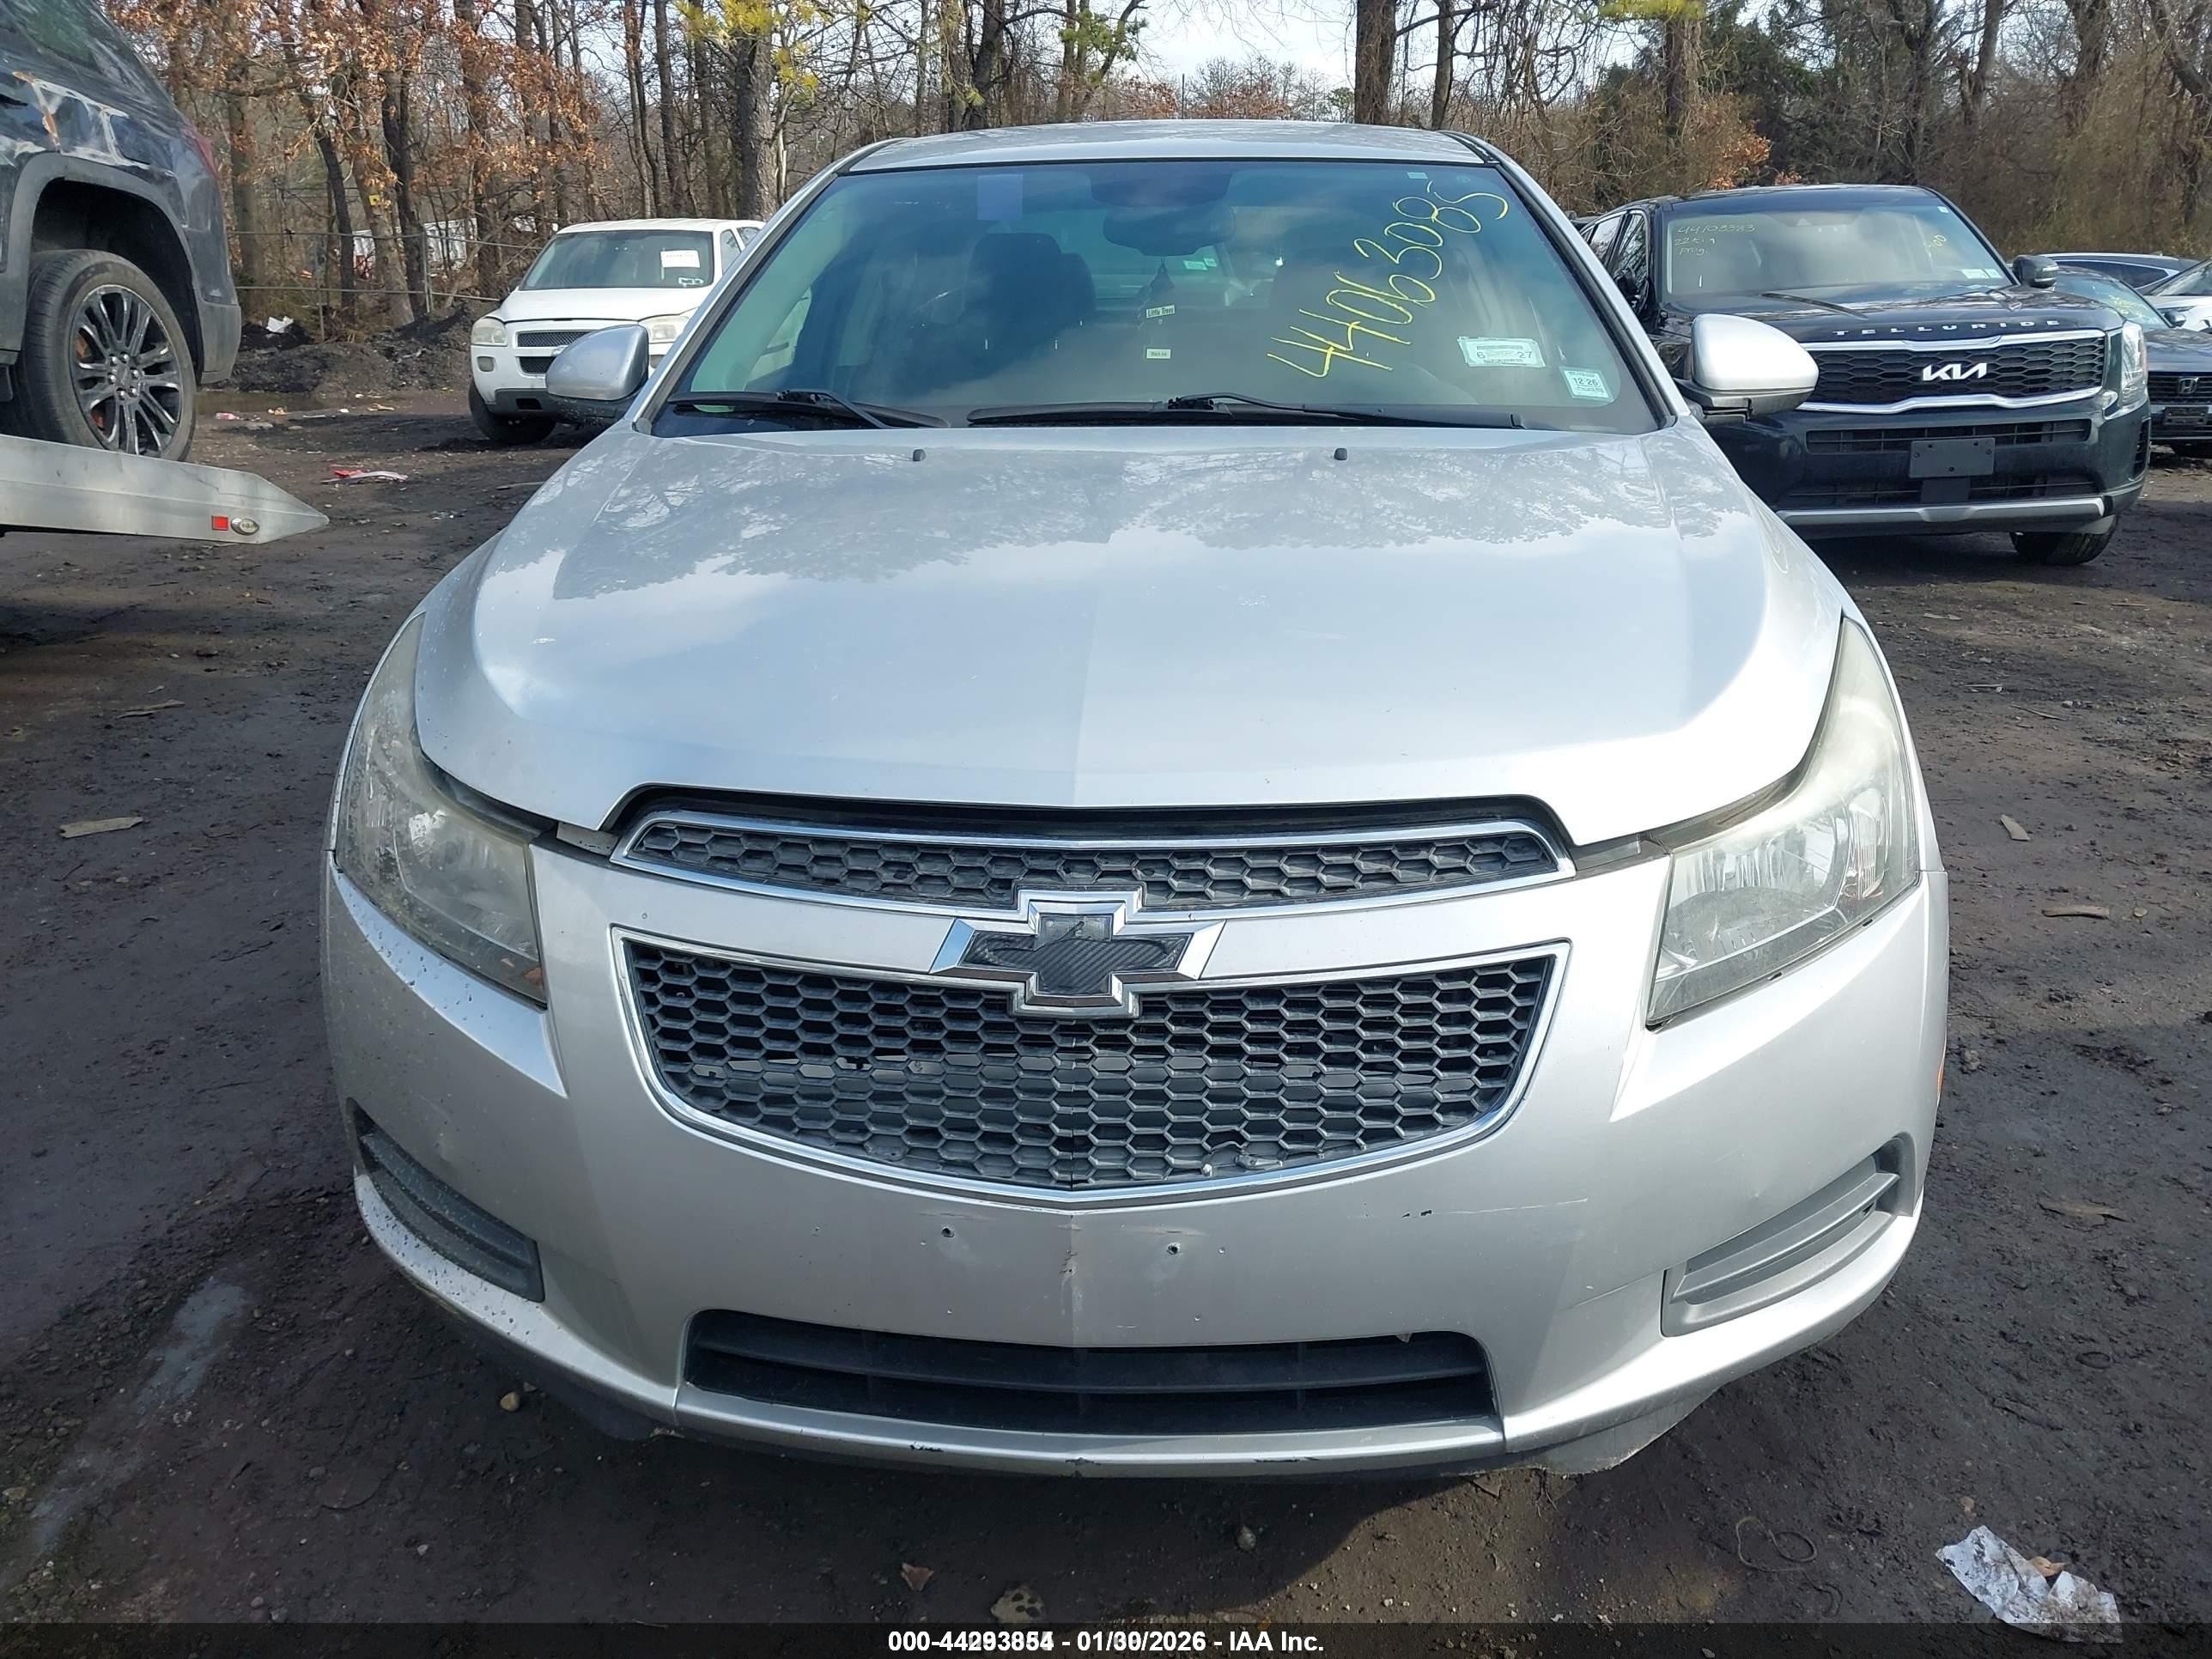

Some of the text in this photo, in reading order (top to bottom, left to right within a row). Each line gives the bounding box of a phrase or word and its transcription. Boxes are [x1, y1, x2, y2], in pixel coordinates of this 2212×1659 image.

[1266, 179, 1510, 378] 44063085
[1832, 319, 2061, 337] TELLURIDE
[1516, 350, 1533, 359] 27
[1922, 362, 1988, 382] KIA
